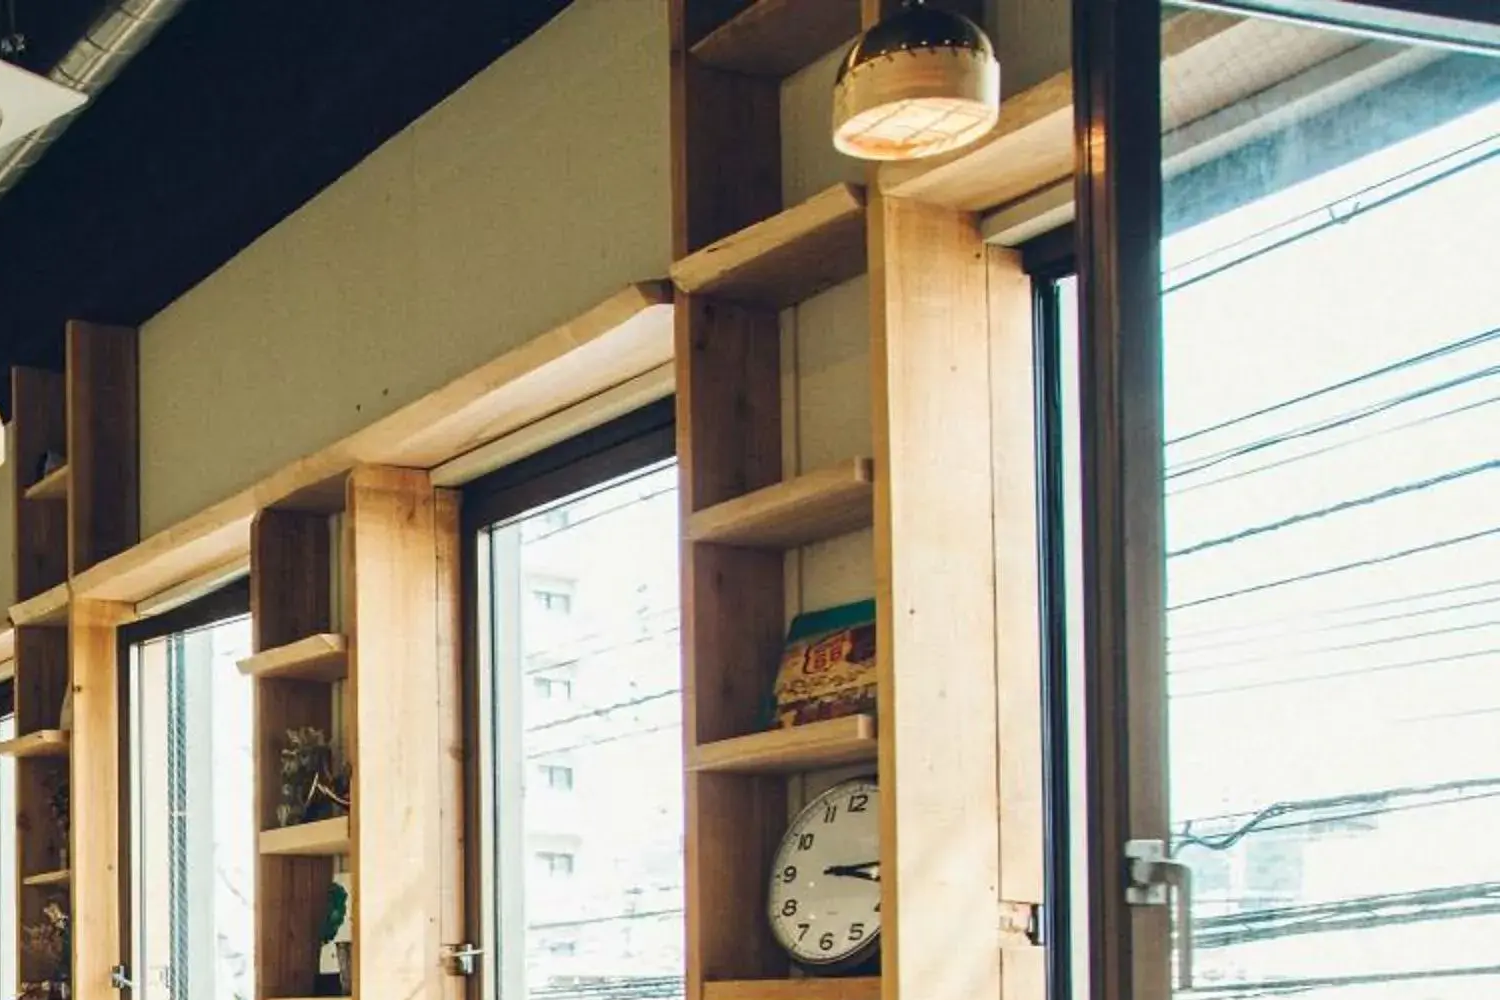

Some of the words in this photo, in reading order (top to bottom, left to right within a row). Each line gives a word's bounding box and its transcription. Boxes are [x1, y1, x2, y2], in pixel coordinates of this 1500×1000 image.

[847, 795, 868, 812] 12
[824, 805, 837, 823] 11
[798, 833, 814, 850] 10
[783, 866, 797, 883] 9
[782, 899, 797, 916] 8
[797, 923, 810, 941] 7
[848, 923, 864, 940] 5
[819, 933, 834, 950] 6
